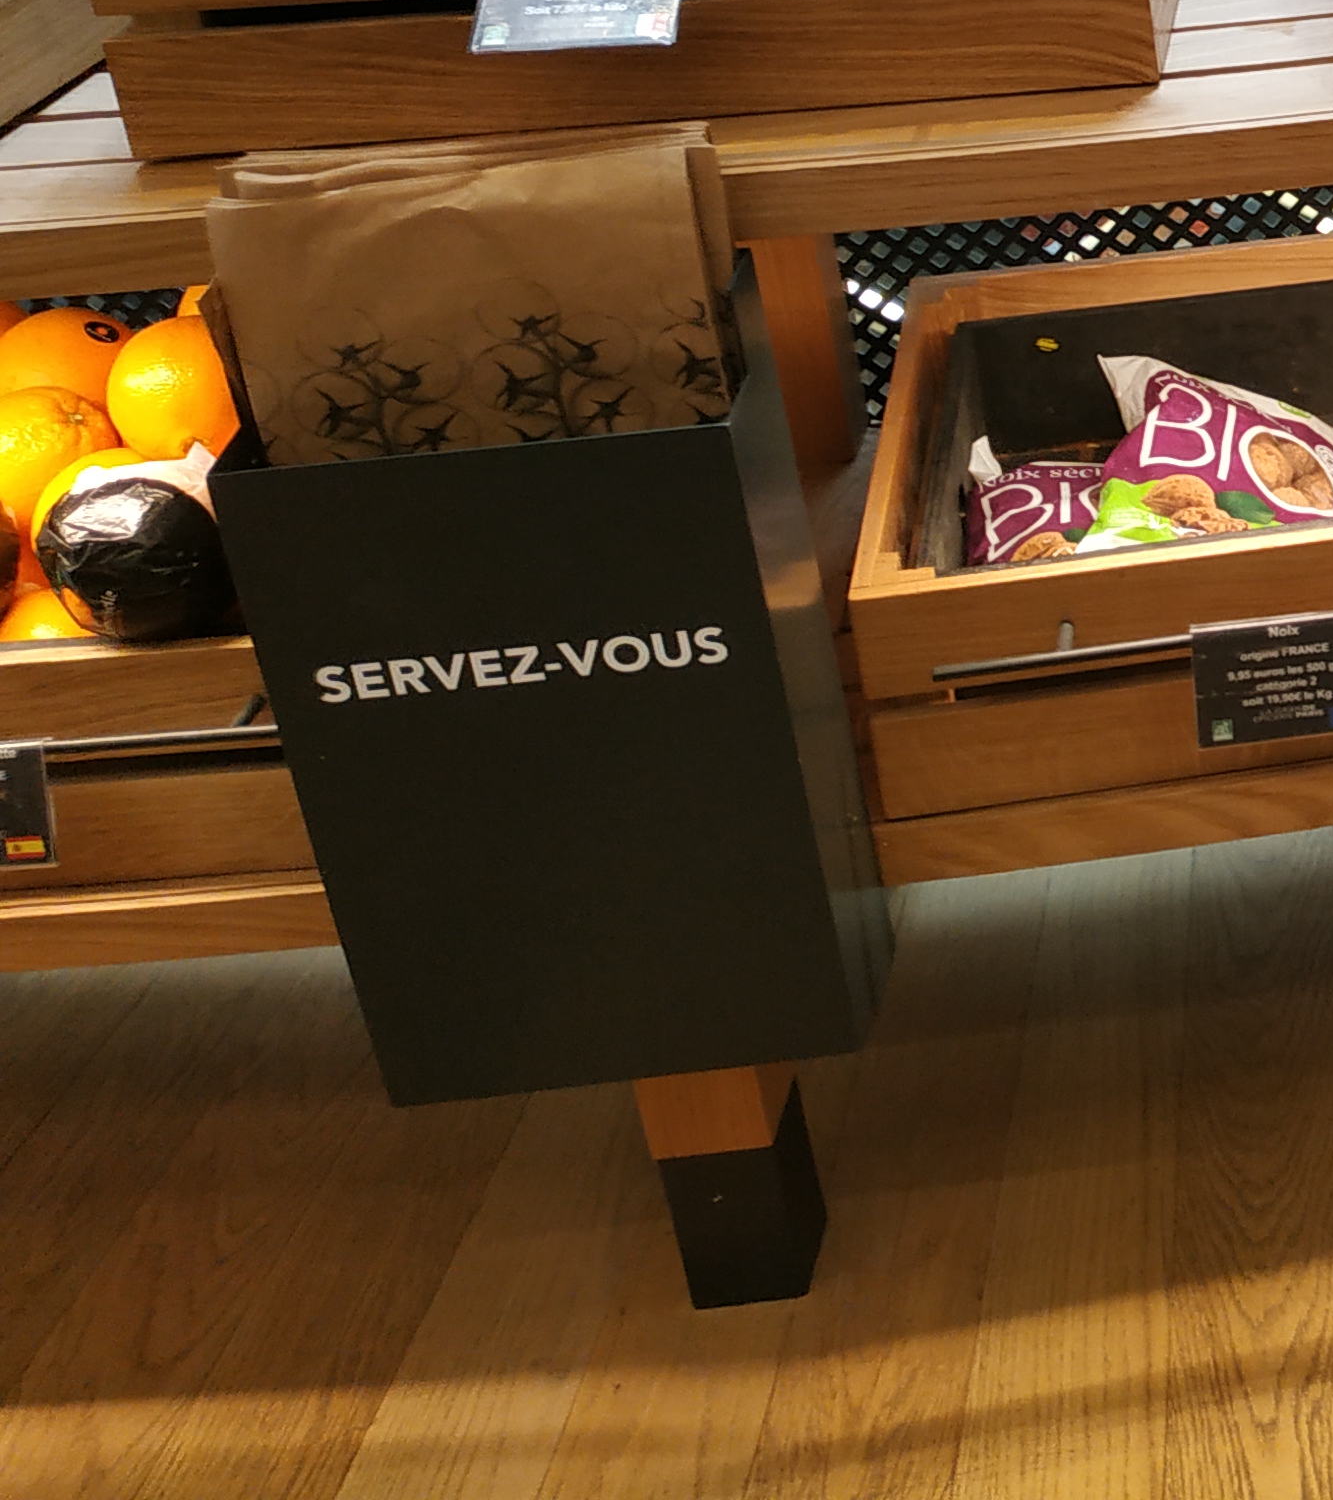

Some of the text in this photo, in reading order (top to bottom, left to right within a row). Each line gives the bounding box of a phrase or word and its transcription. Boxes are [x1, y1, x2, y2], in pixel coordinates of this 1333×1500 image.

[1267, 625, 1300, 638] Noix
[1239, 642, 1330, 663] origine FRANCE
[314, 626, 730, 704] SERVEZ-VOUS
[1253, 667, 1285, 679] euros
[1286, 664, 1304, 675] les
[1242, 696, 1264, 708] soit
[1316, 688, 1333, 701] Kg
